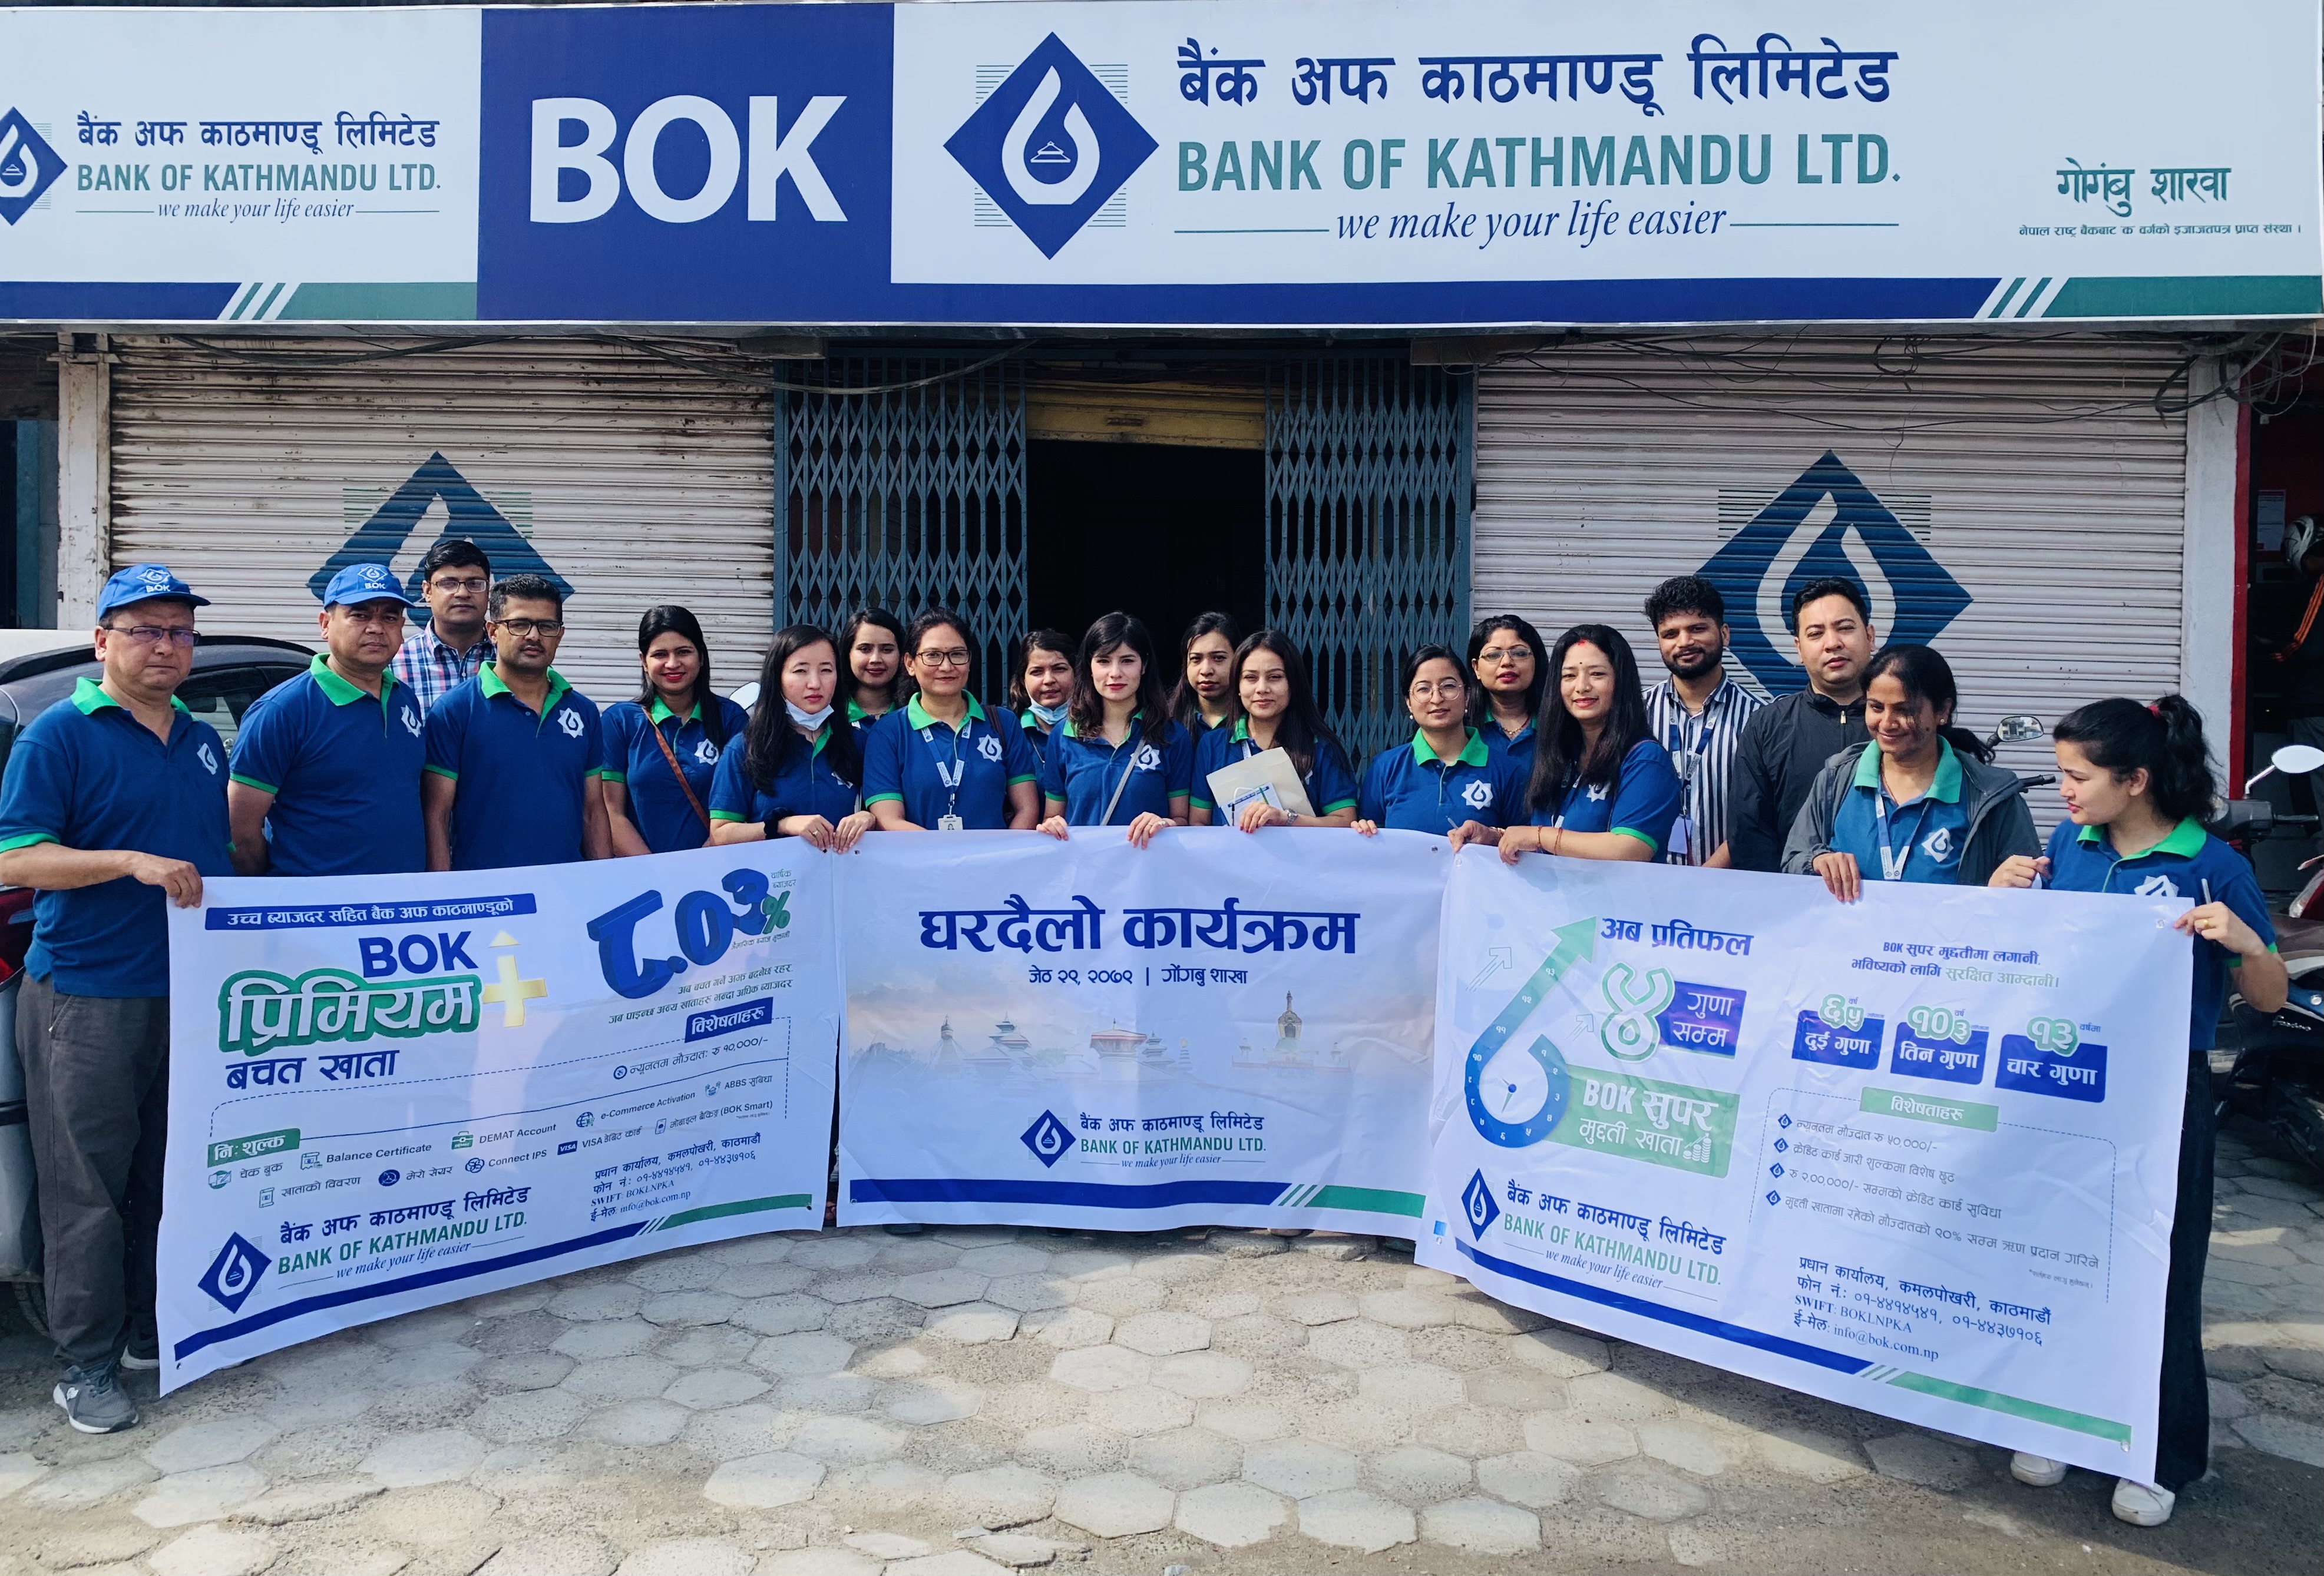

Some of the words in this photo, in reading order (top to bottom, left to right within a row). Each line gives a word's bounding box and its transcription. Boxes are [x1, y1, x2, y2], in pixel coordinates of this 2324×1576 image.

[1178, 37, 1265, 107] बैंक
[1292, 57, 1395, 105] अफ
[1418, 54, 1664, 116] काठमाण्डू
[1687, 34, 1899, 105] लिमिटेड
[77, 110, 121, 147] बैंक
[135, 121, 186, 147] अफ
[200, 121, 323, 154] काठमाण्डू
[335, 111, 439, 148] लिमिटेड
[530, 94, 848, 223] BOK
[1178, 140, 1322, 191] BANK
[1343, 138, 1407, 190] OF
[1428, 134, 1773, 188] KATHMANDU
[1796, 134, 1900, 184] LTD.
[77, 164, 150, 191] BANK
[161, 164, 193, 191] OF
[204, 163, 377, 191] KATHMANDU
[388, 163, 441, 191] LTD.
[2150, 168, 2232, 204] शाखा
[158, 204, 180, 217] we
[184, 198, 230, 217] make
[233, 203, 270, 223] your
[275, 198, 300, 223] life
[305, 201, 355, 218] easier
[1335, 215, 1385, 240] we
[1389, 205, 1477, 237] make
[1484, 210, 1561, 247] your
[1568, 199, 1619, 249] life
[1627, 204, 1727, 235] easier
[2019, 224, 2051, 236] नेपाल
[2054, 227, 2078, 237] राष्ट्र
[2140, 223, 2170, 234] वर्गको
[146, 584, 170, 592] BOK
[227, 912, 262, 926] उच्च
[267, 910, 325, 924] ब्याजदर
[328, 906, 368, 923] सहित
[399, 906, 428, 919] अफ
[920, 894, 1105, 953] घरदैलो
[1123, 898, 1360, 953] कार्यक्रम
[1601, 918, 1643, 942] अब
[1651, 919, 1754, 956] प्रतिफल
[1883, 942, 1902, 953] BOK
[1906, 943, 1936, 957] सुपर
[358, 931, 478, 978] BOK
[1029, 965, 1053, 983] जेठ
[1058, 970, 1080, 985] २९,
[1088, 970, 1133, 984] २०७९
[1211, 969, 1248, 984] शाखा
[1852, 958, 1906, 974] भविष्यको
[1910, 964, 1941, 976] लागि
[1946, 966, 1993, 982] सुरक्षित
[223, 972, 478, 1051] प्रिमियम
[1602, 965, 1674, 1060] ४
[1687, 992, 1735, 1019] गुणा
[1673, 1021, 1729, 1047] सम्म
[1910, 1008, 1951, 1038] १०
[2029, 1018, 2076, 1054] १३
[1804, 1032, 1830, 1051] दुई
[1834, 1036, 1872, 1055] गुणा
[1900, 1041, 1936, 1062] तिन
[1939, 1049, 1979, 1070] गुणा
[225, 1057, 307, 1090] बचत
[319, 1049, 400, 1081] खाता
[2007, 1058, 2044, 1078] चार
[2049, 1064, 2098, 1085] गुणा
[725, 1080, 746, 1090] ABBS
[601, 1102, 655, 1120] e-Commerce
[657, 1092, 696, 1107] Activation
[1583, 1079, 1637, 1114] BOK
[1642, 1091, 1719, 1131] सुपर
[480, 1131, 514, 1144] DEMAT
[517, 1124, 557, 1137] Account
[1080, 1113, 1102, 1131] बैंक
[1109, 1118, 1135, 1131] अफ
[1142, 1116, 1204, 1133] काठमाण्डू
[1210, 1111, 1264, 1130] लिमिटेड
[327, 1151, 372, 1163] Balance
[376, 1144, 432, 1158] Certificate
[560, 1142, 577, 1152] VISA
[1081, 1139, 1118, 1154] BANK
[1123, 1140, 1139, 1154] OF
[1145, 1137, 1233, 1154] KATHMANDU
[1239, 1137, 1266, 1151] LTD.
[1635, 1129, 1684, 1155] खाता
[240, 1168, 261, 1178] चेक
[264, 1163, 283, 1176] बुक
[488, 1153, 530, 1167] Connect
[533, 1150, 547, 1160] IPS
[1135, 1157, 1158, 1168] make
[1159, 1156, 1178, 1169] your
[1179, 1154, 1194, 1166] life
[1195, 1155, 1222, 1164] easier
[282, 1181, 322, 1197] खाताको
[325, 1177, 362, 1189] विवरण
[280, 1221, 313, 1245] बैंक
[322, 1214, 361, 1236] अफ
[370, 1199, 456, 1227] काठमाण्डू
[464, 1187, 532, 1212] लिमिटेड
[1508, 1178, 1532, 1207] बैंक
[1539, 1193, 1570, 1215] अफ
[1577, 1201, 1652, 1241] काठमाण्डू
[1659, 1216, 1727, 1255] लिमिटेड
[278, 1249, 332, 1275] BANK
[340, 1240, 363, 1261] OF
[370, 1219, 488, 1254] KATHMANDU
[494, 1211, 527, 1231] LTD.
[1504, 1213, 1545, 1240] BANK
[1550, 1224, 1570, 1245] OF
[1575, 1231, 1682, 1276] KATHMANDU
[1688, 1260, 1721, 1286] LTD.
[336, 1266, 352, 1279] we
[355, 1257, 386, 1276] make
[389, 1253, 415, 1272] your
[417, 1245, 436, 1263] life
[438, 1241, 471, 1257] easier
[1546, 1249, 1559, 1262] we
[1561, 1251, 1588, 1270] make
[1588, 1260, 1612, 1276] your
[1613, 1264, 1631, 1282] life
[1632, 1272, 1663, 1289] easier
[1800, 1257, 1829, 1274] प्रधान
[1797, 1274, 1821, 1293] फोन
[1795, 1294, 1837, 1314] SWIFT:
[1840, 1306, 1912, 1333] BOKLNPKA
[1834, 1324, 1939, 1360] info@bok.com.np
